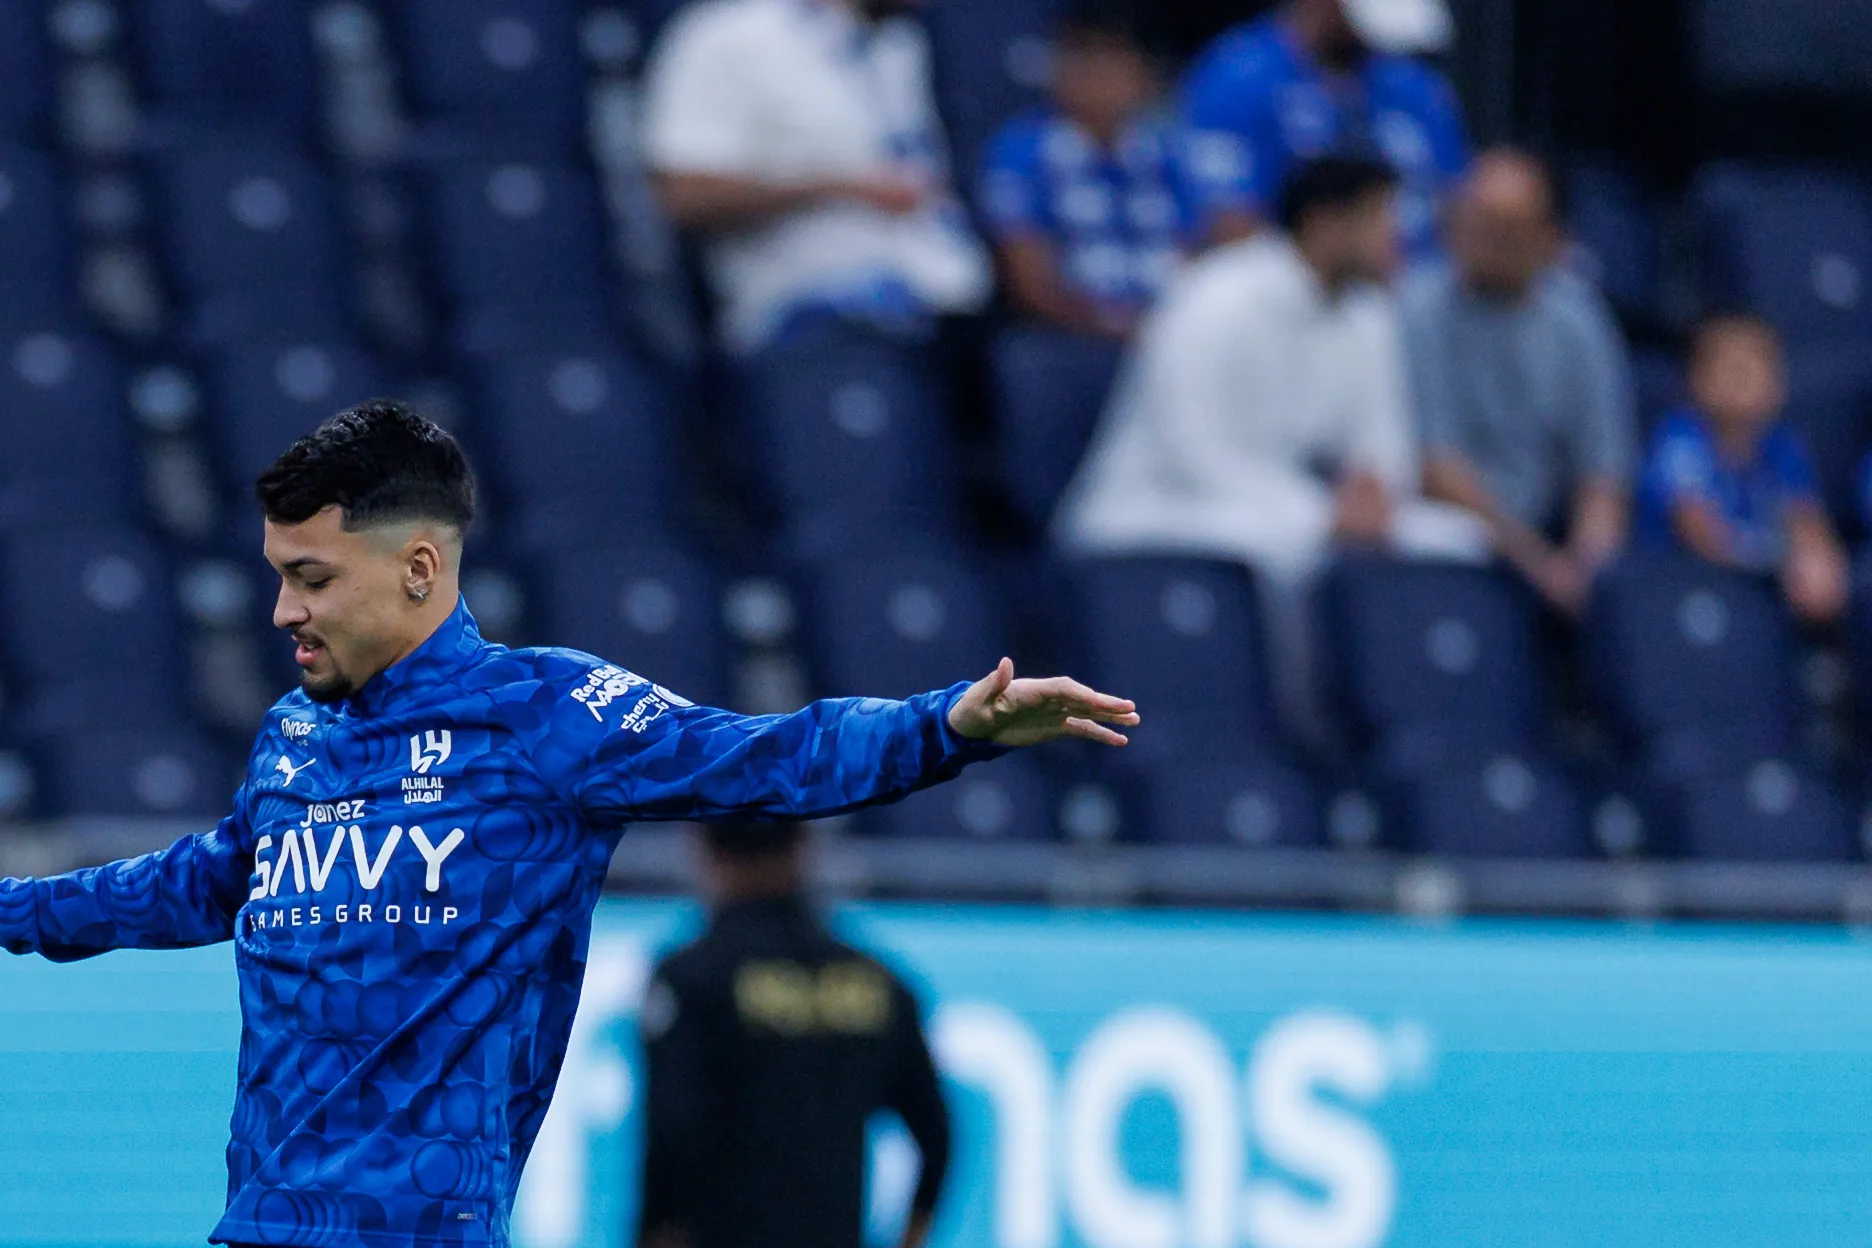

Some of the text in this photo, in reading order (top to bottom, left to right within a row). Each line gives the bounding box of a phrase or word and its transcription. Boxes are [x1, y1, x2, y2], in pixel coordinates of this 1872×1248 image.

[401, 776, 445, 790] ALHILAL
[249, 825, 465, 901] SAVVY
[335, 903, 458, 925] GROUP
